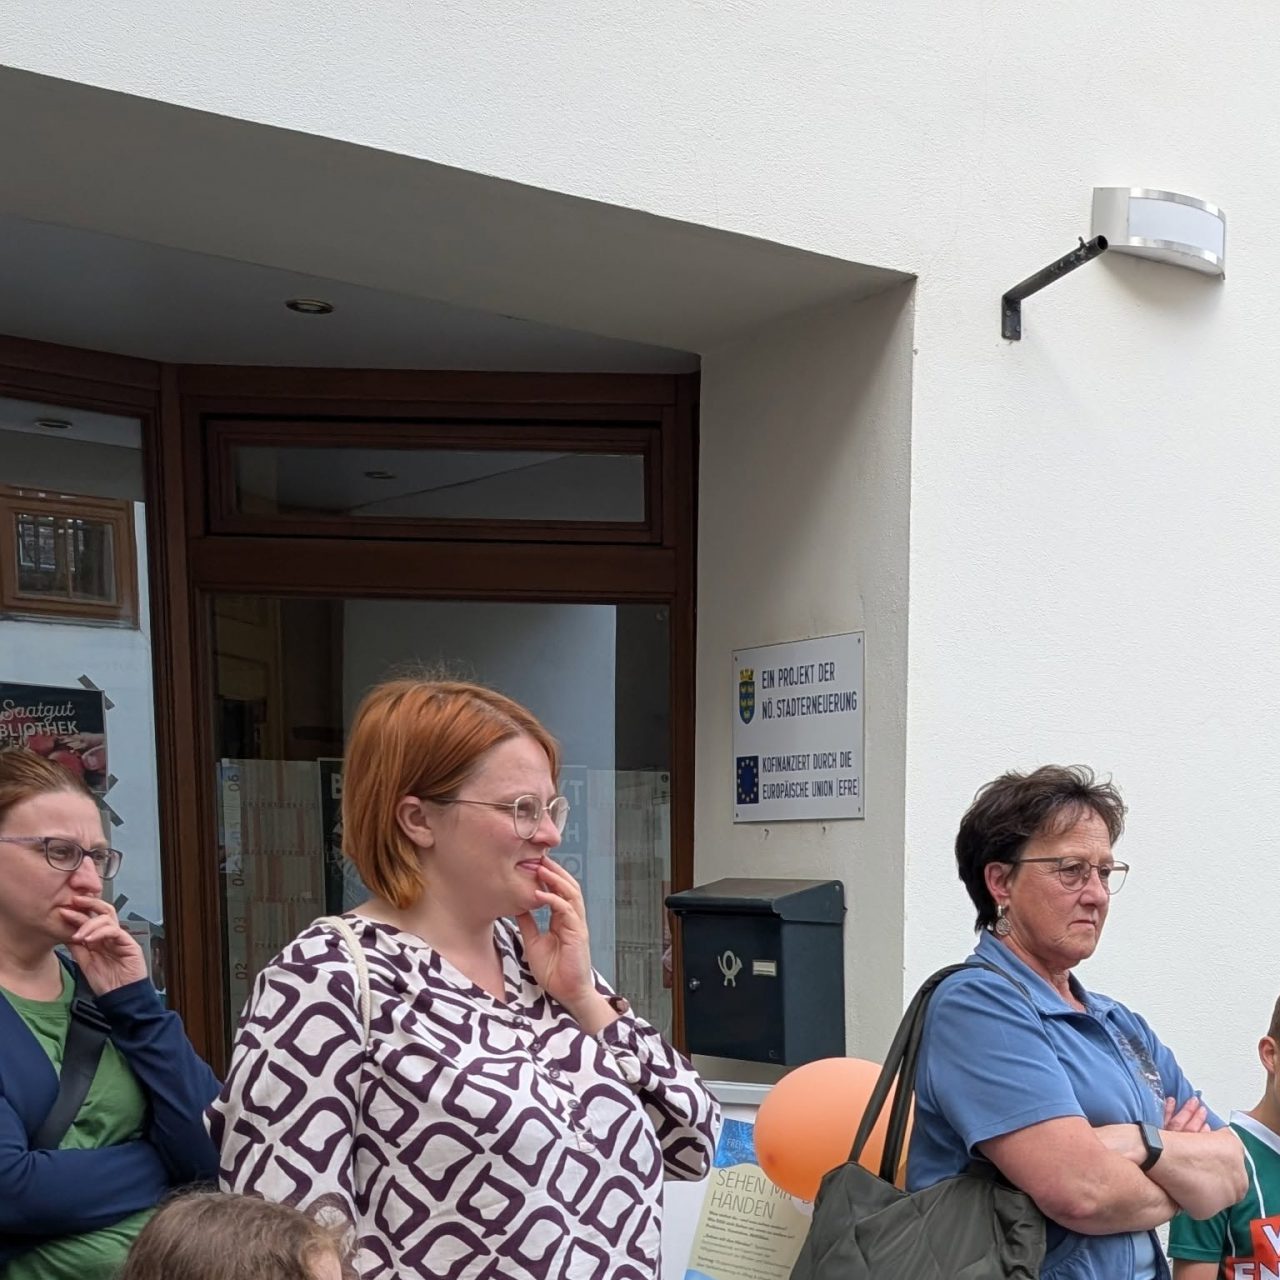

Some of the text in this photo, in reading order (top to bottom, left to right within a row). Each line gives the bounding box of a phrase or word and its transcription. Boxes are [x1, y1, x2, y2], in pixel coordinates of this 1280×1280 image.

[762, 662, 835, 689] EIN PROJEKT DER
[0, 700, 76, 723] Saatgut
[776, 691, 857, 718] STADTERNEUERUNG
[762, 751, 852, 773] KOFINANZIERT DURCH DIE
[762, 780, 809, 800] EUROPÄISCHE
[812, 780, 834, 797] UNION
[716, 1168, 767, 1195] SEHEN
[710, 1190, 775, 1219] HÄNDEN
